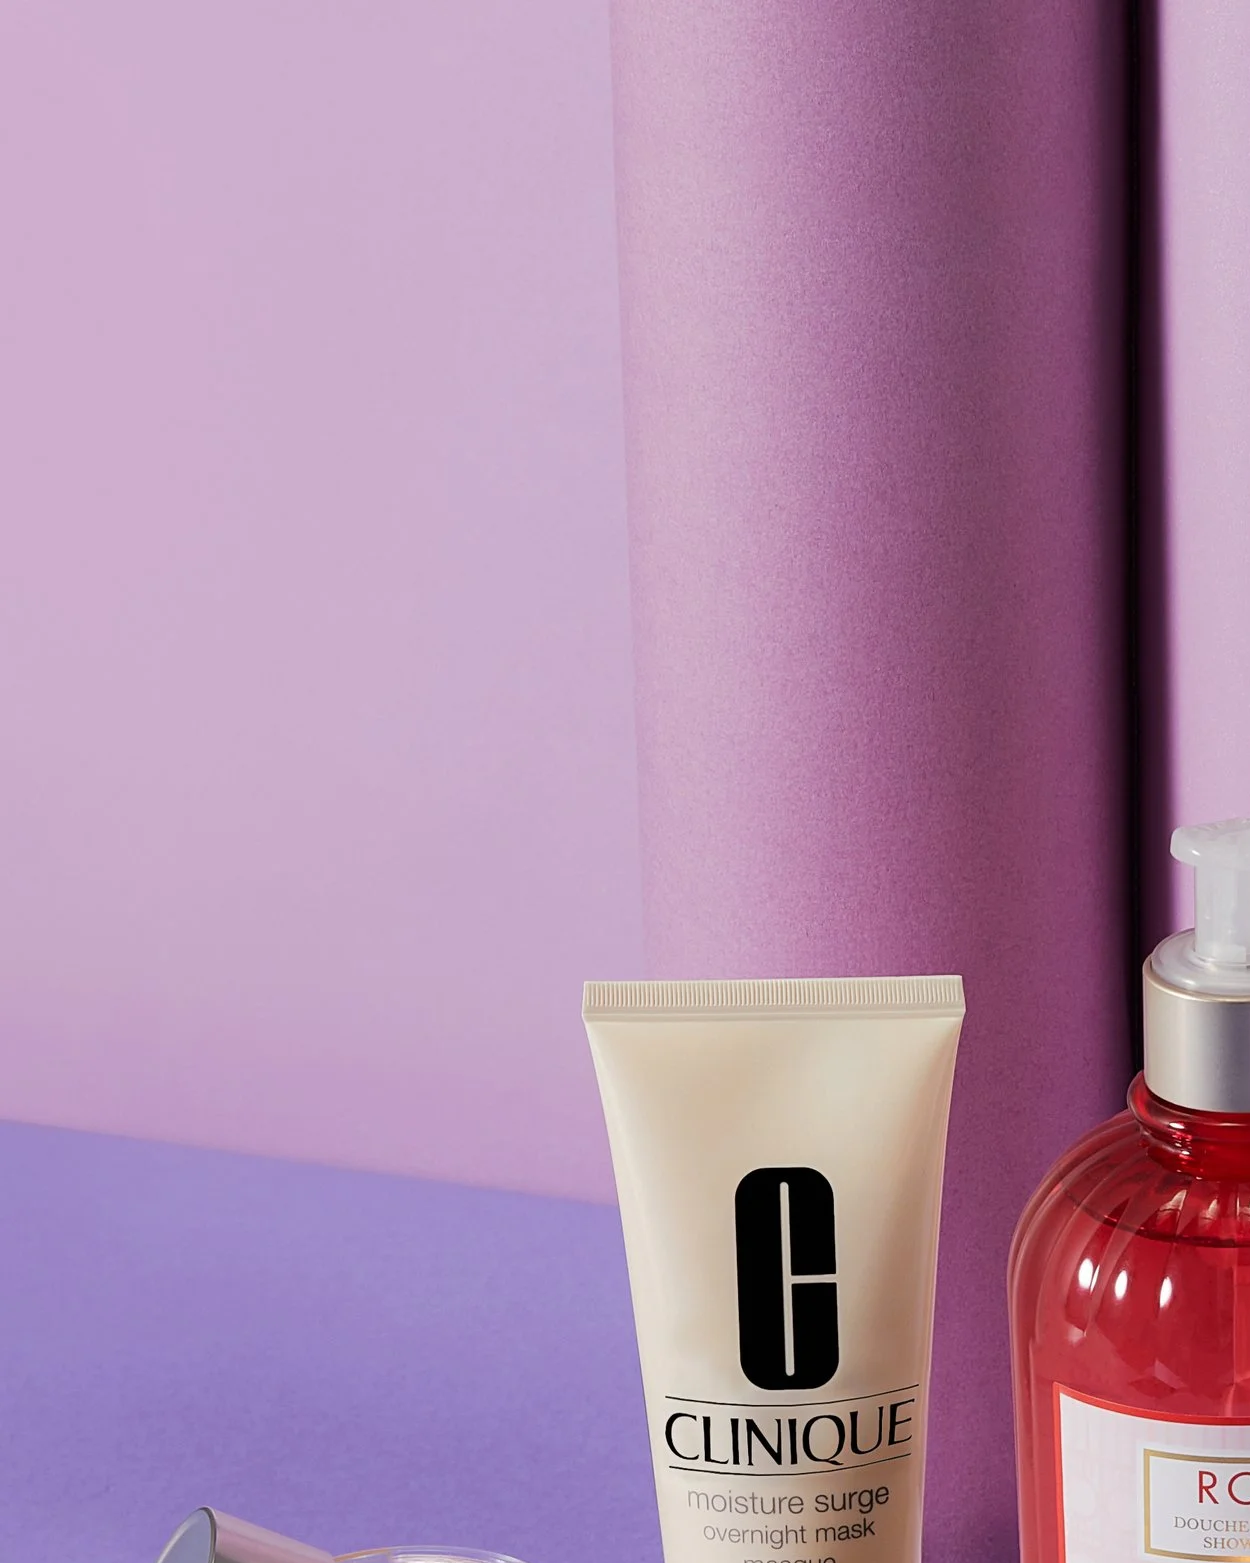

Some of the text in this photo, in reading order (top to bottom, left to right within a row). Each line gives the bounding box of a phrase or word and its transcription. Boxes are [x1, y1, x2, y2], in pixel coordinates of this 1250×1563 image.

[664, 1399, 912, 1469] CLINIQUE
[687, 1486, 889, 1520] moisture surge
[703, 1518, 876, 1549] overnight mask
[1174, 1515, 1249, 1533] DOUCHE
